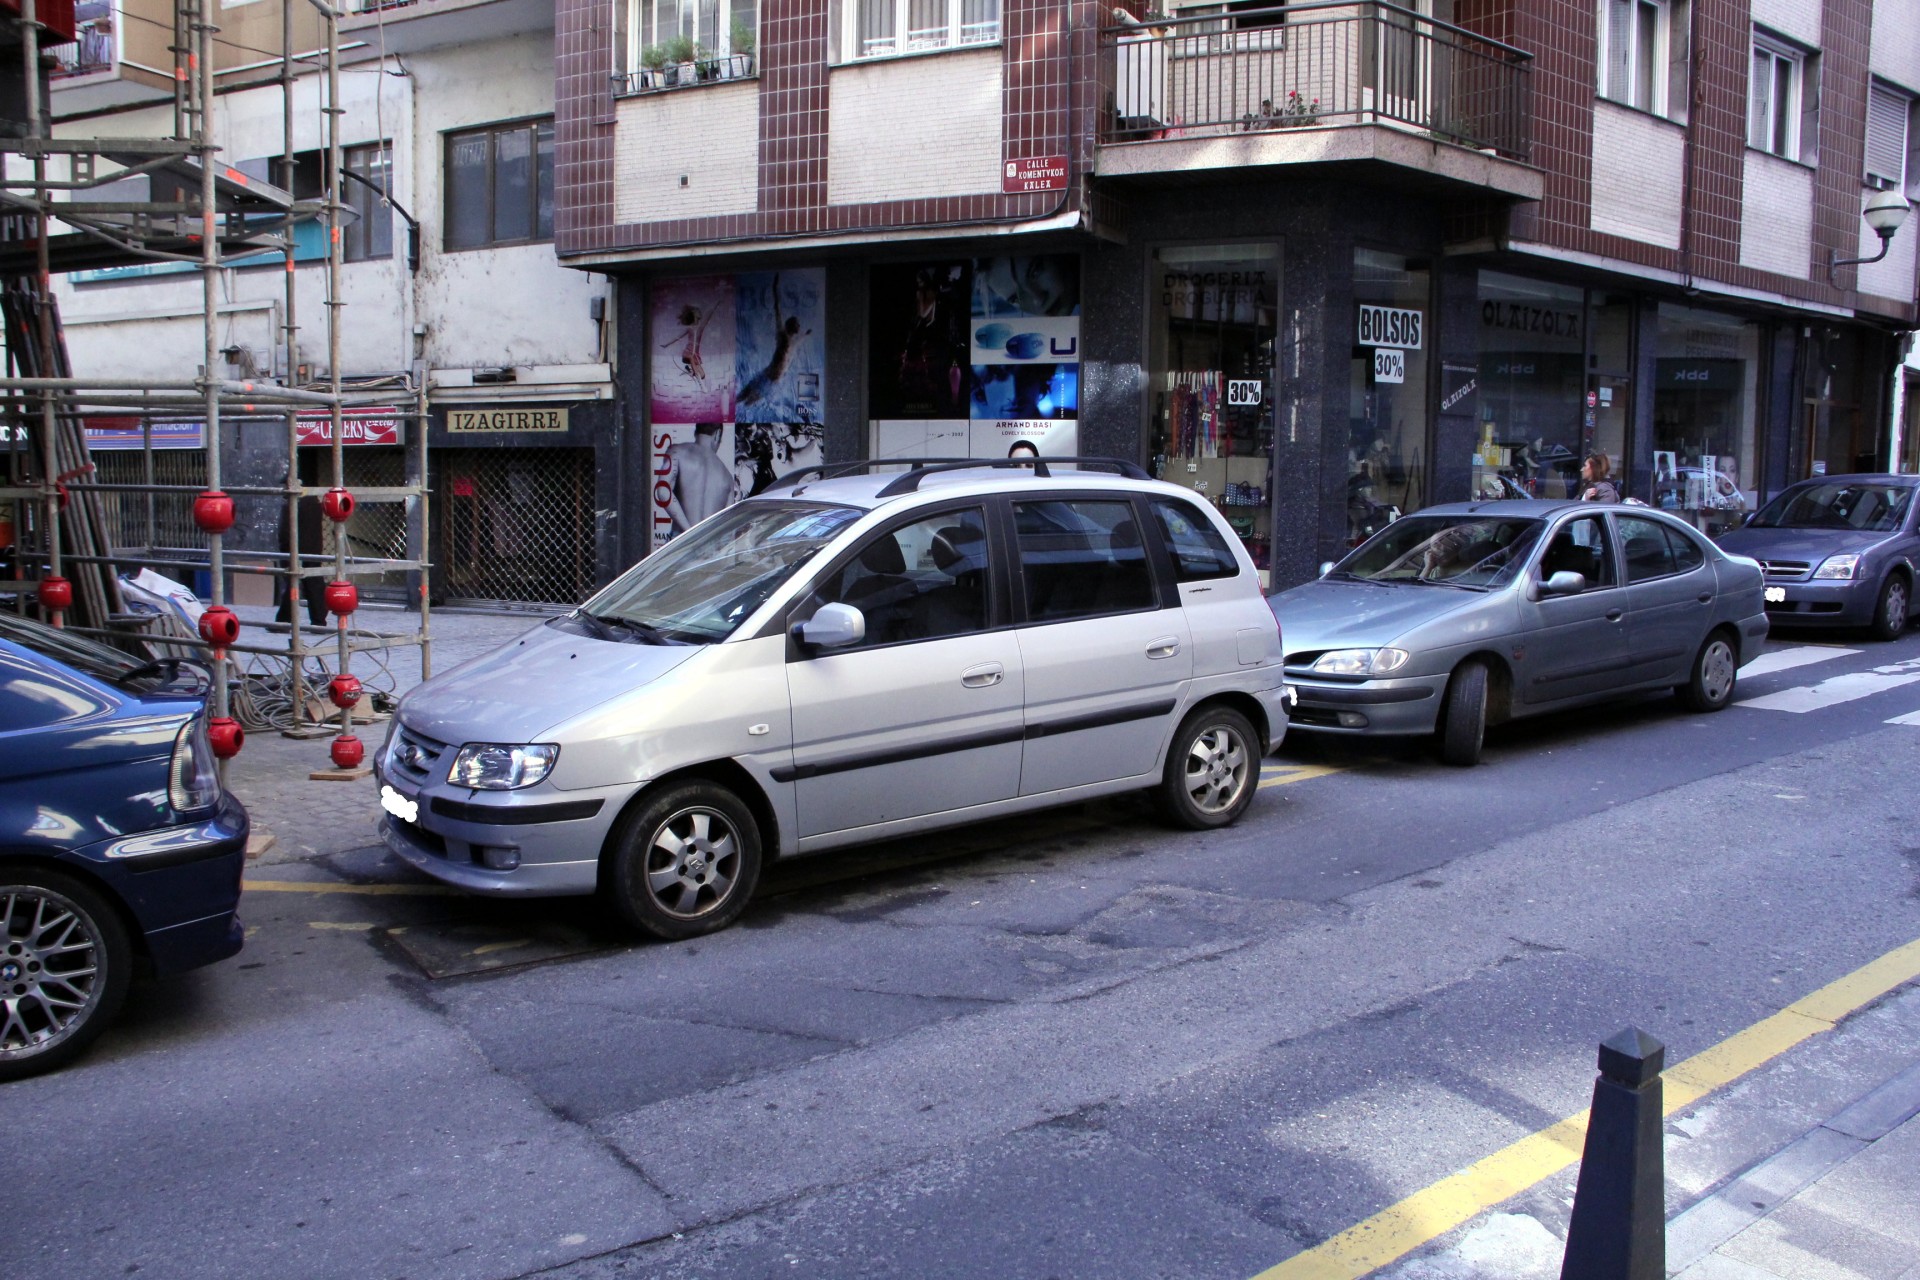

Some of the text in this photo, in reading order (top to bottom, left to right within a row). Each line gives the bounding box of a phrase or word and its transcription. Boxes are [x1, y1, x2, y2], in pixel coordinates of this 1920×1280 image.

[1026, 158, 1049, 169] CALLE
[1023, 179, 1051, 190] KALEA
[1164, 271, 1266, 288] DROGERIA
[1360, 308, 1420, 346] BOLSOS
[1375, 353, 1403, 378] 30%
[1230, 382, 1260, 403] 30%
[1442, 378, 1477, 411] OLAIZOLA
[797, 406, 817, 415] BOSS
[453, 411, 561, 430] IZAGIRRE
[654, 433, 672, 529] TOUS
[654, 533, 673, 542] MAN
